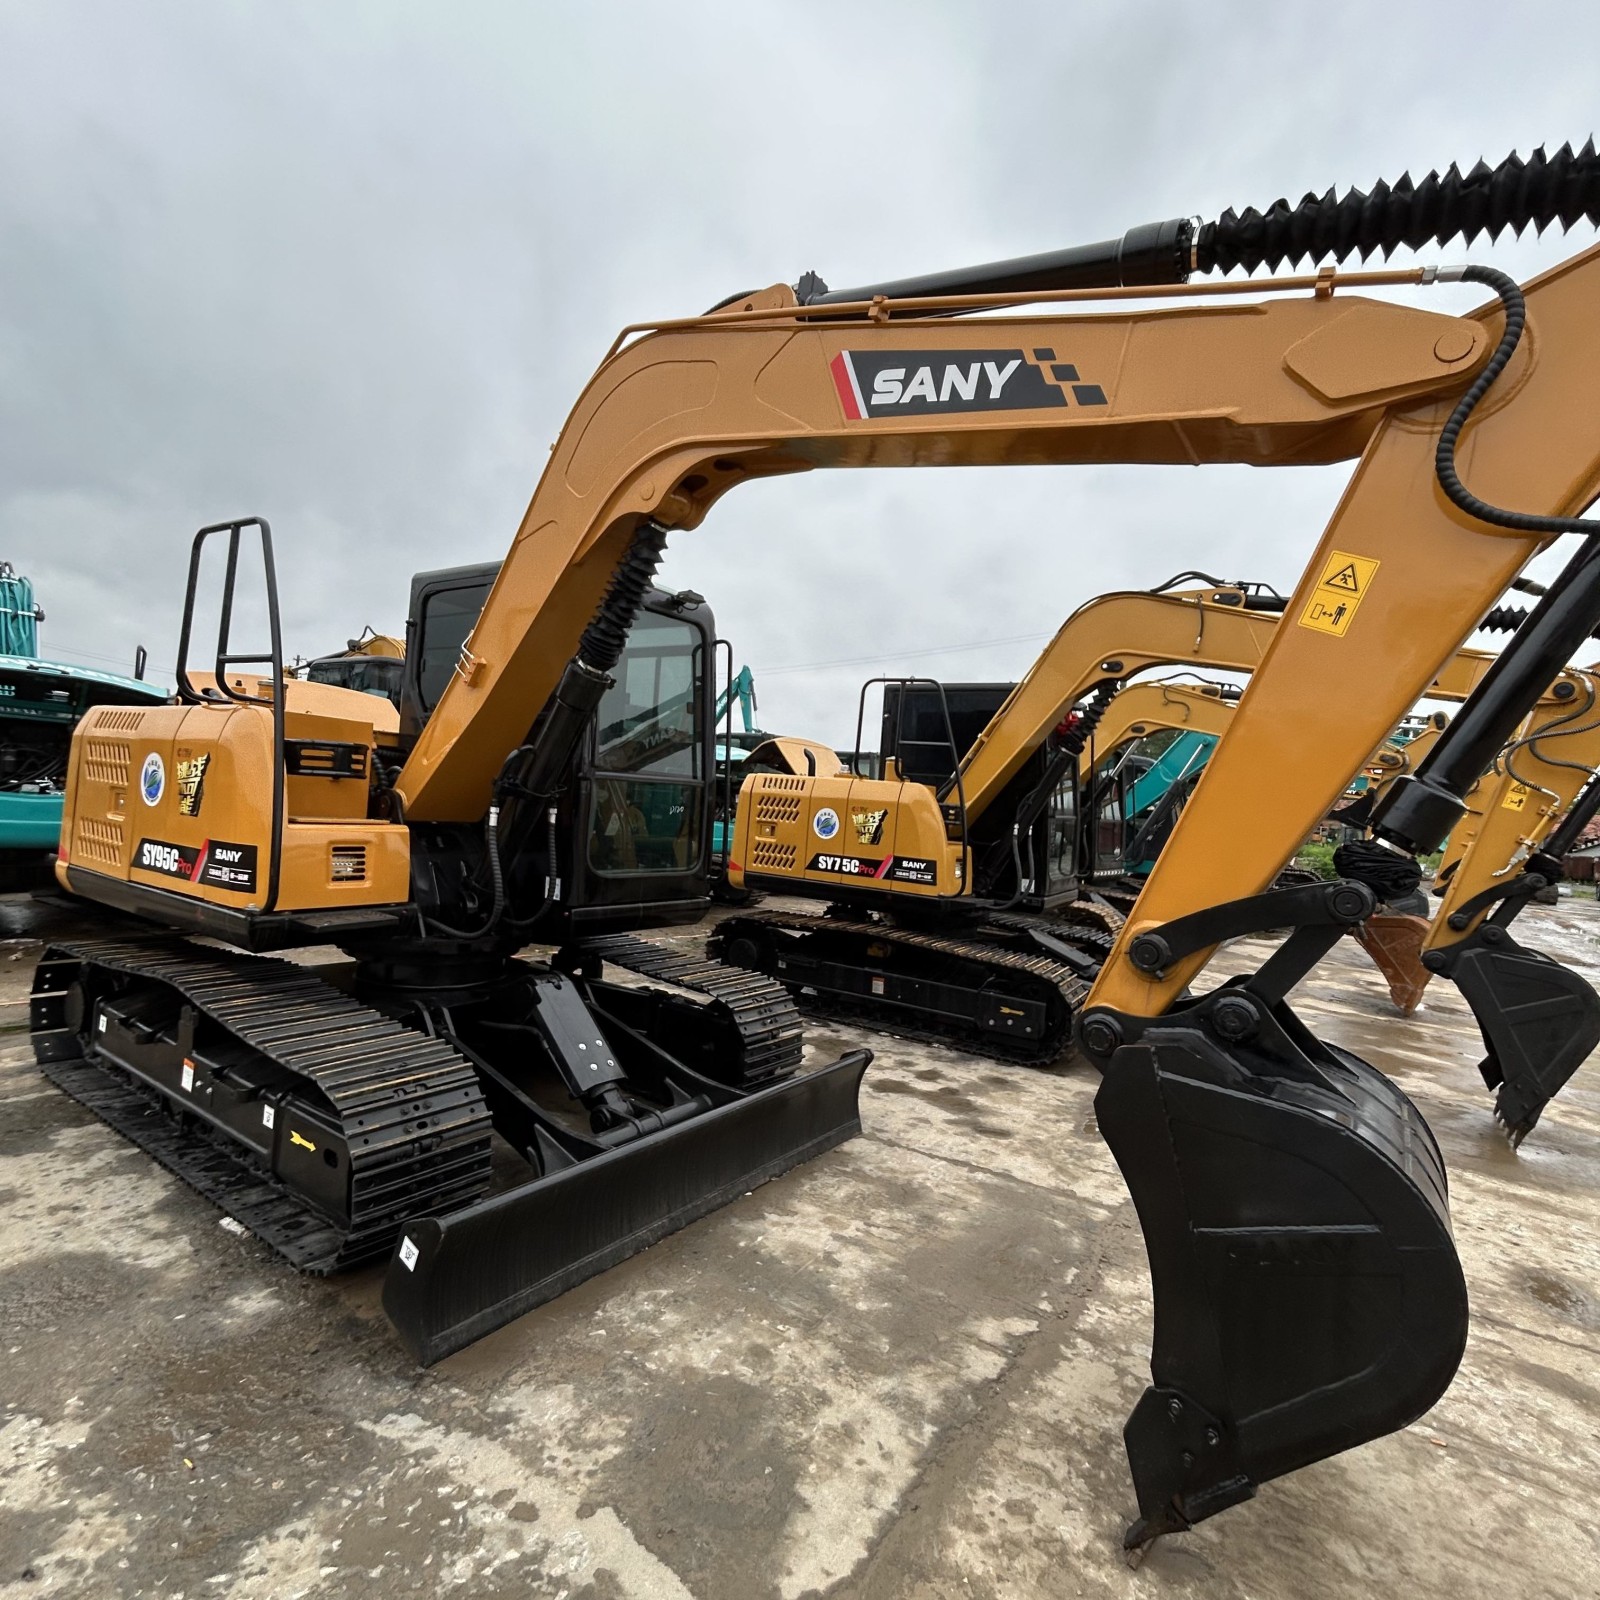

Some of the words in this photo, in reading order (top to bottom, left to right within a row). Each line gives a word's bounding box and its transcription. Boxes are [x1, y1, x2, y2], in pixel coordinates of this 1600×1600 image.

[870, 359, 1022, 405] SANY
[142, 843, 179, 872] SY95C
[177, 858, 192, 874] Pro
[215, 848, 242, 862] SANY
[818, 855, 859, 873] SY75C
[858, 864, 875, 875] Pro
[902, 860, 927, 869] SANY
